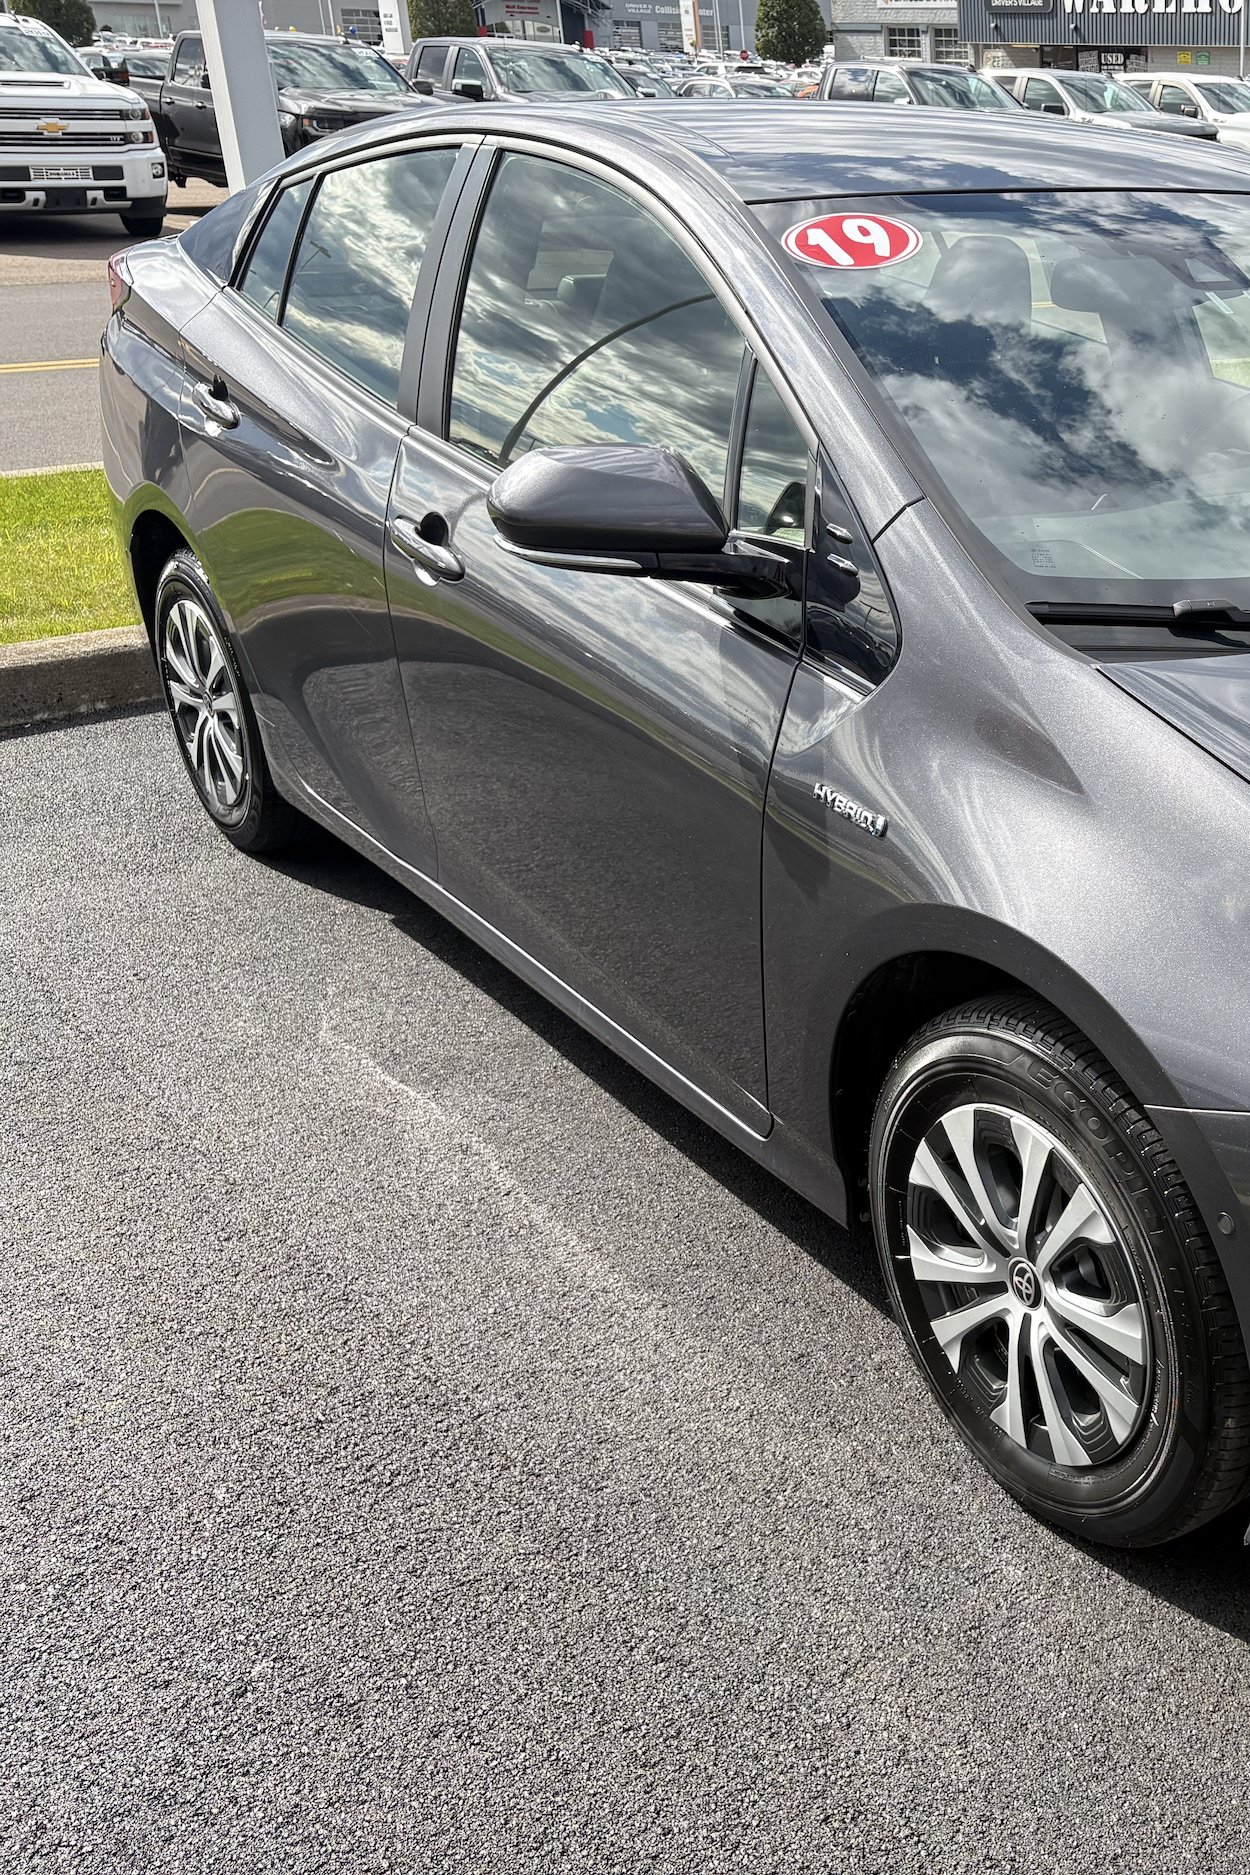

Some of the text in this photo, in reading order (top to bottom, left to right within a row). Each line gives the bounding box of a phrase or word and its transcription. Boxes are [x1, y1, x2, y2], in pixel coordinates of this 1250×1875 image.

[1101, 53, 1125, 65] USED
[806, 218, 891, 266] 19
[813, 782, 878, 836] HYBRID
